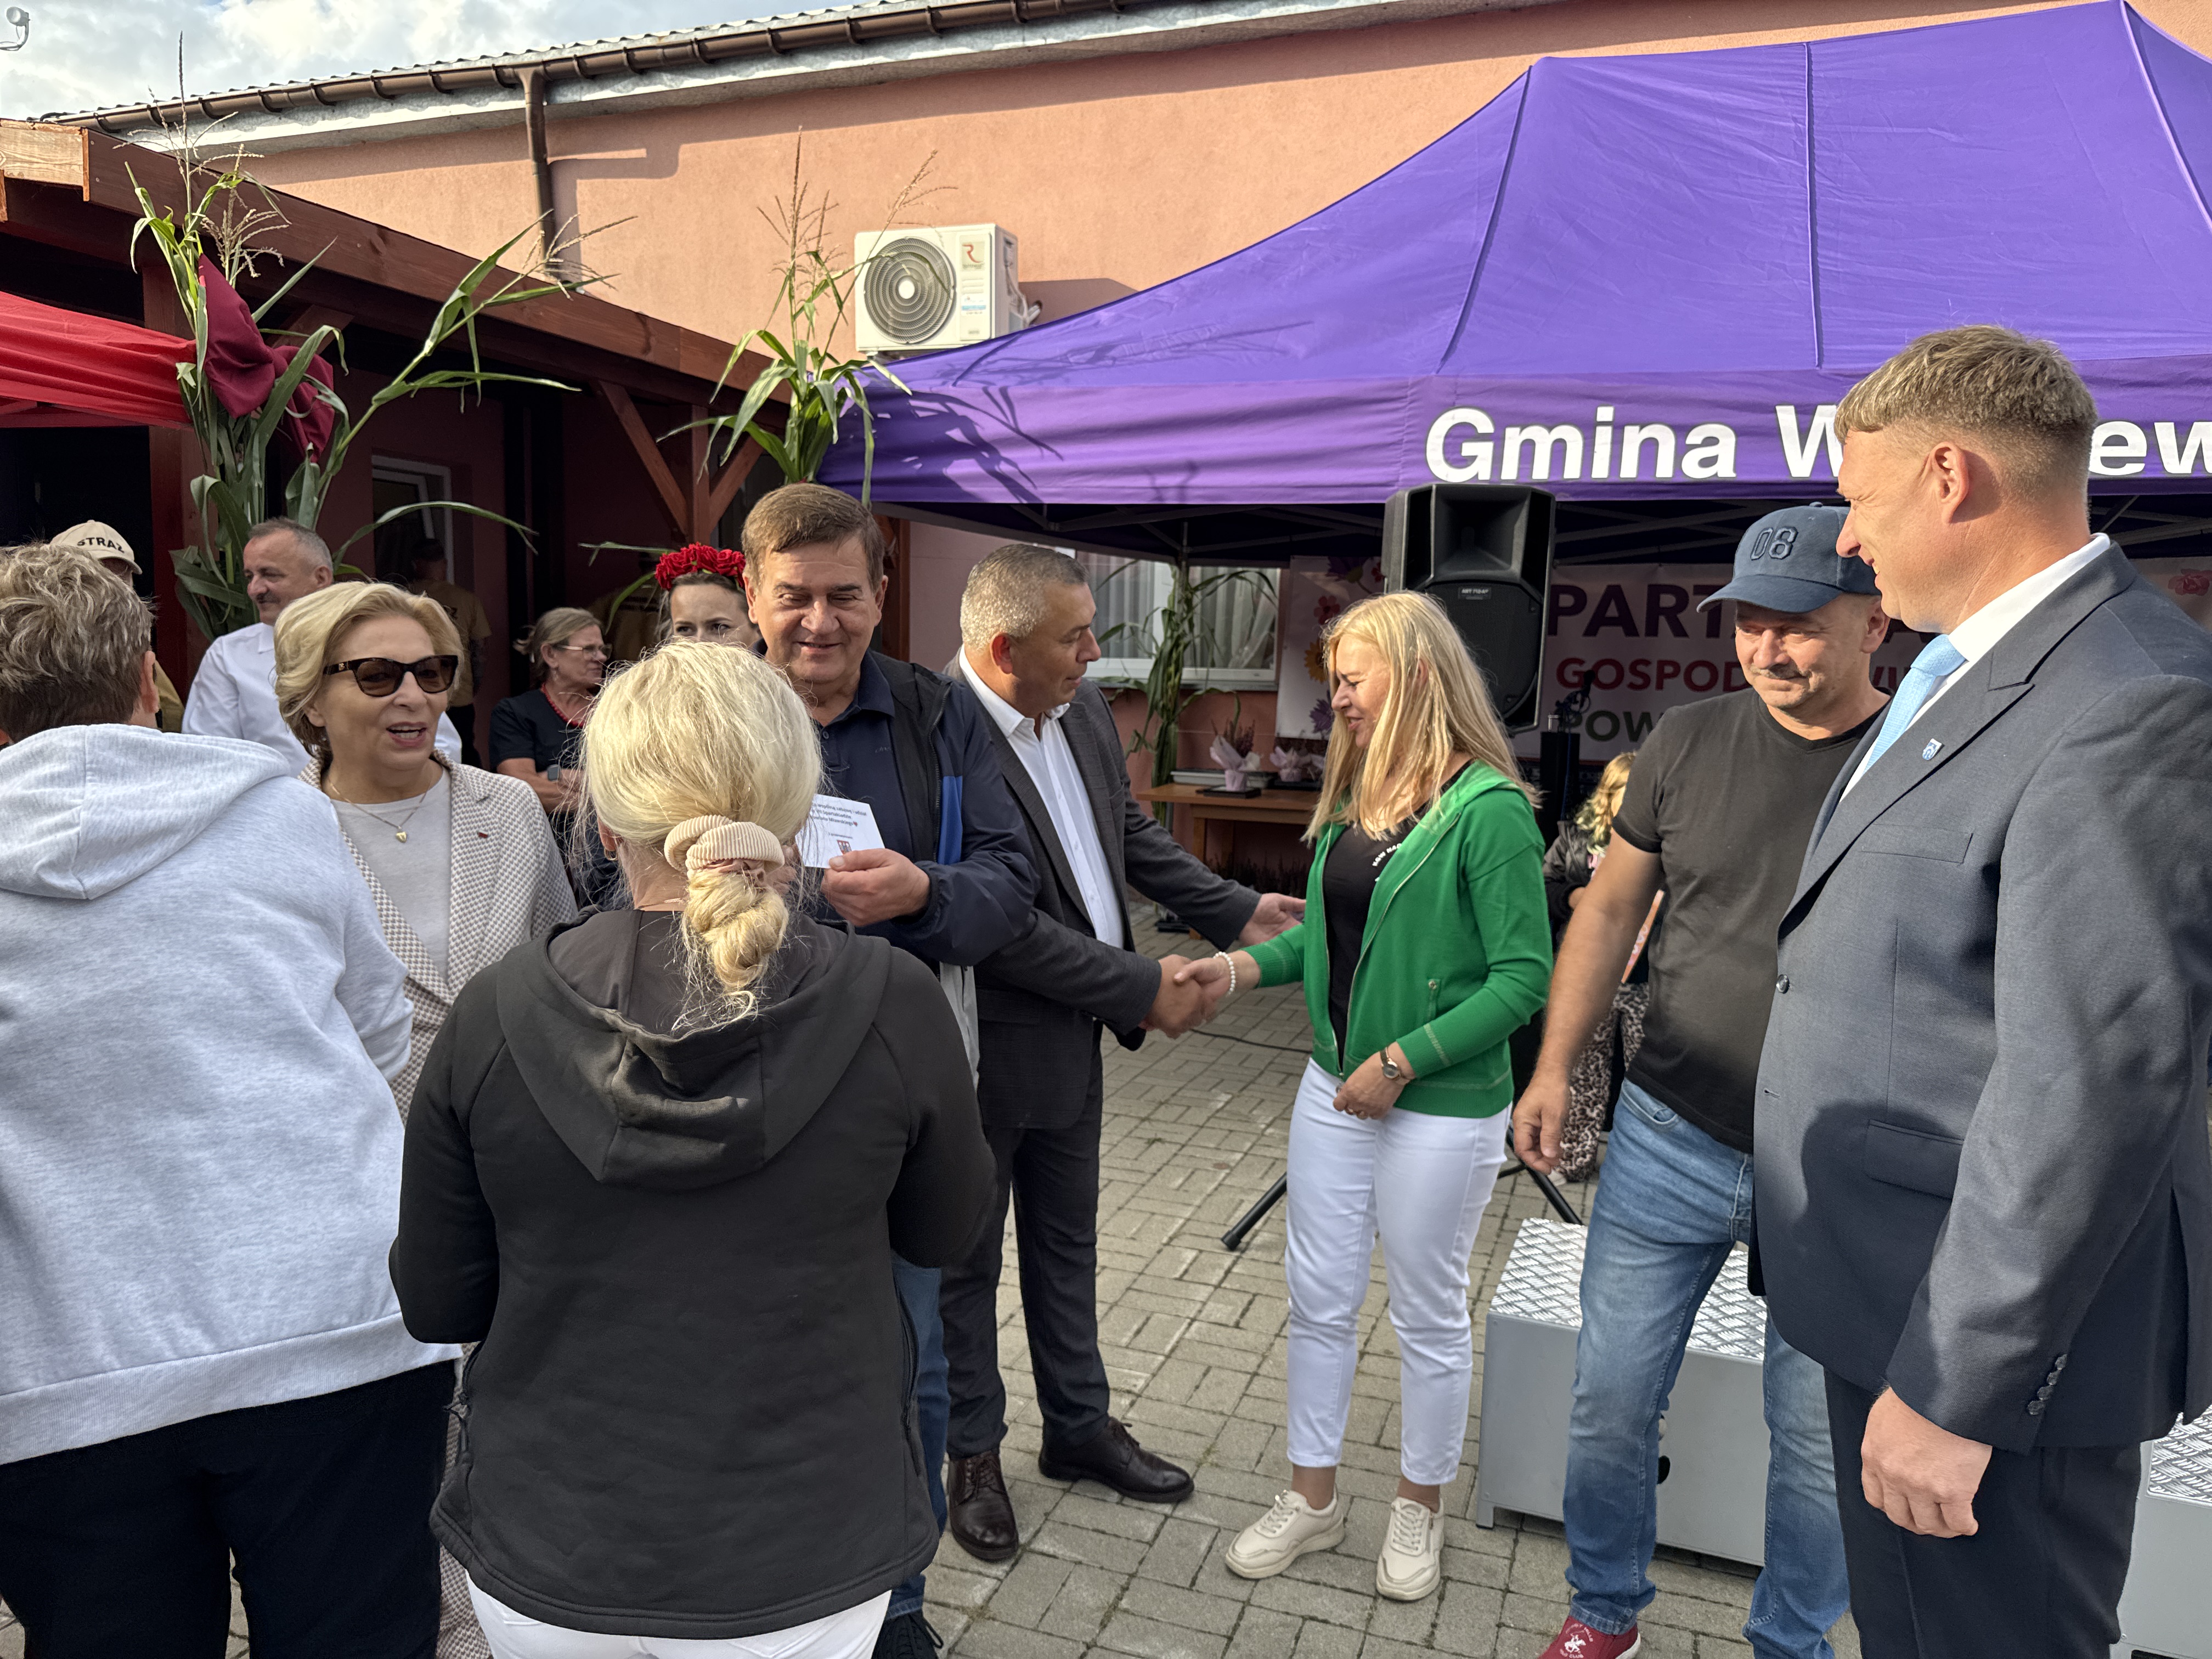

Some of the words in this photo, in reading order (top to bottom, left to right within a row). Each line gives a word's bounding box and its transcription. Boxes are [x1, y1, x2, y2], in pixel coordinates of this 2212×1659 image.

[1426, 405, 1737, 483] Gmina
[1750, 527, 1799, 561] 08
[1547, 584, 1736, 639] PART
[1556, 658, 1753, 693] GOSPOD
[1557, 709, 1666, 743] POW
